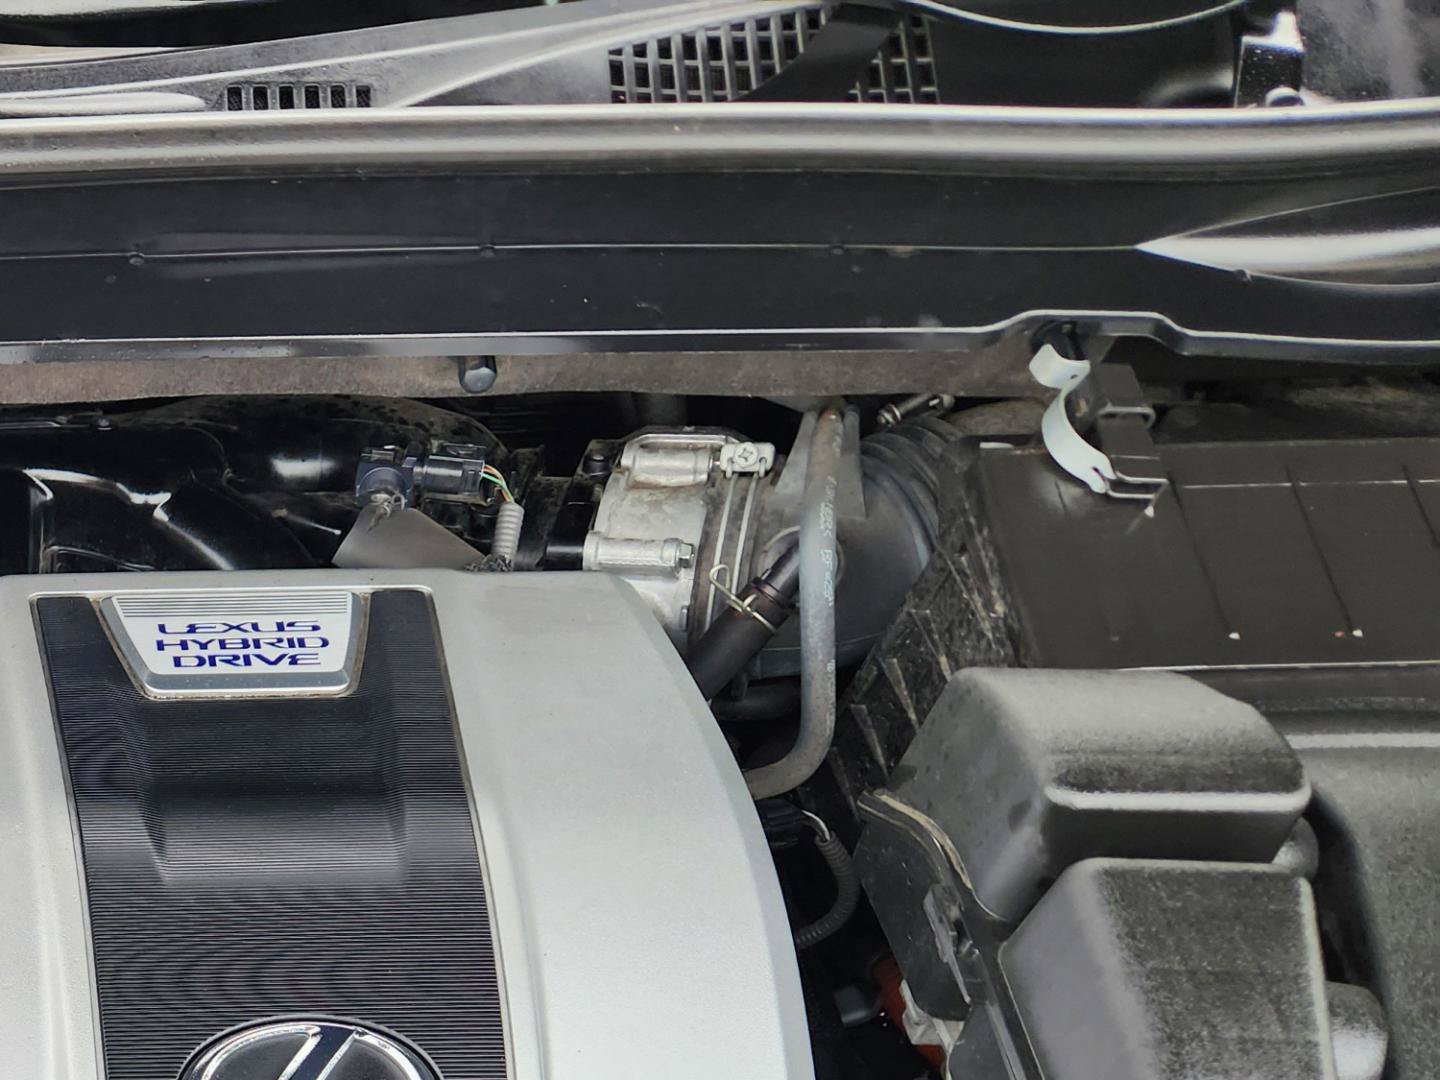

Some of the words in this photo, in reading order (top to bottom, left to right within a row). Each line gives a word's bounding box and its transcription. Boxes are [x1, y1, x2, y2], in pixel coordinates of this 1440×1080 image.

[157, 620, 322, 635] LEXUS
[156, 636, 330, 651] HYBRID
[172, 653, 322, 668] DRIVE
